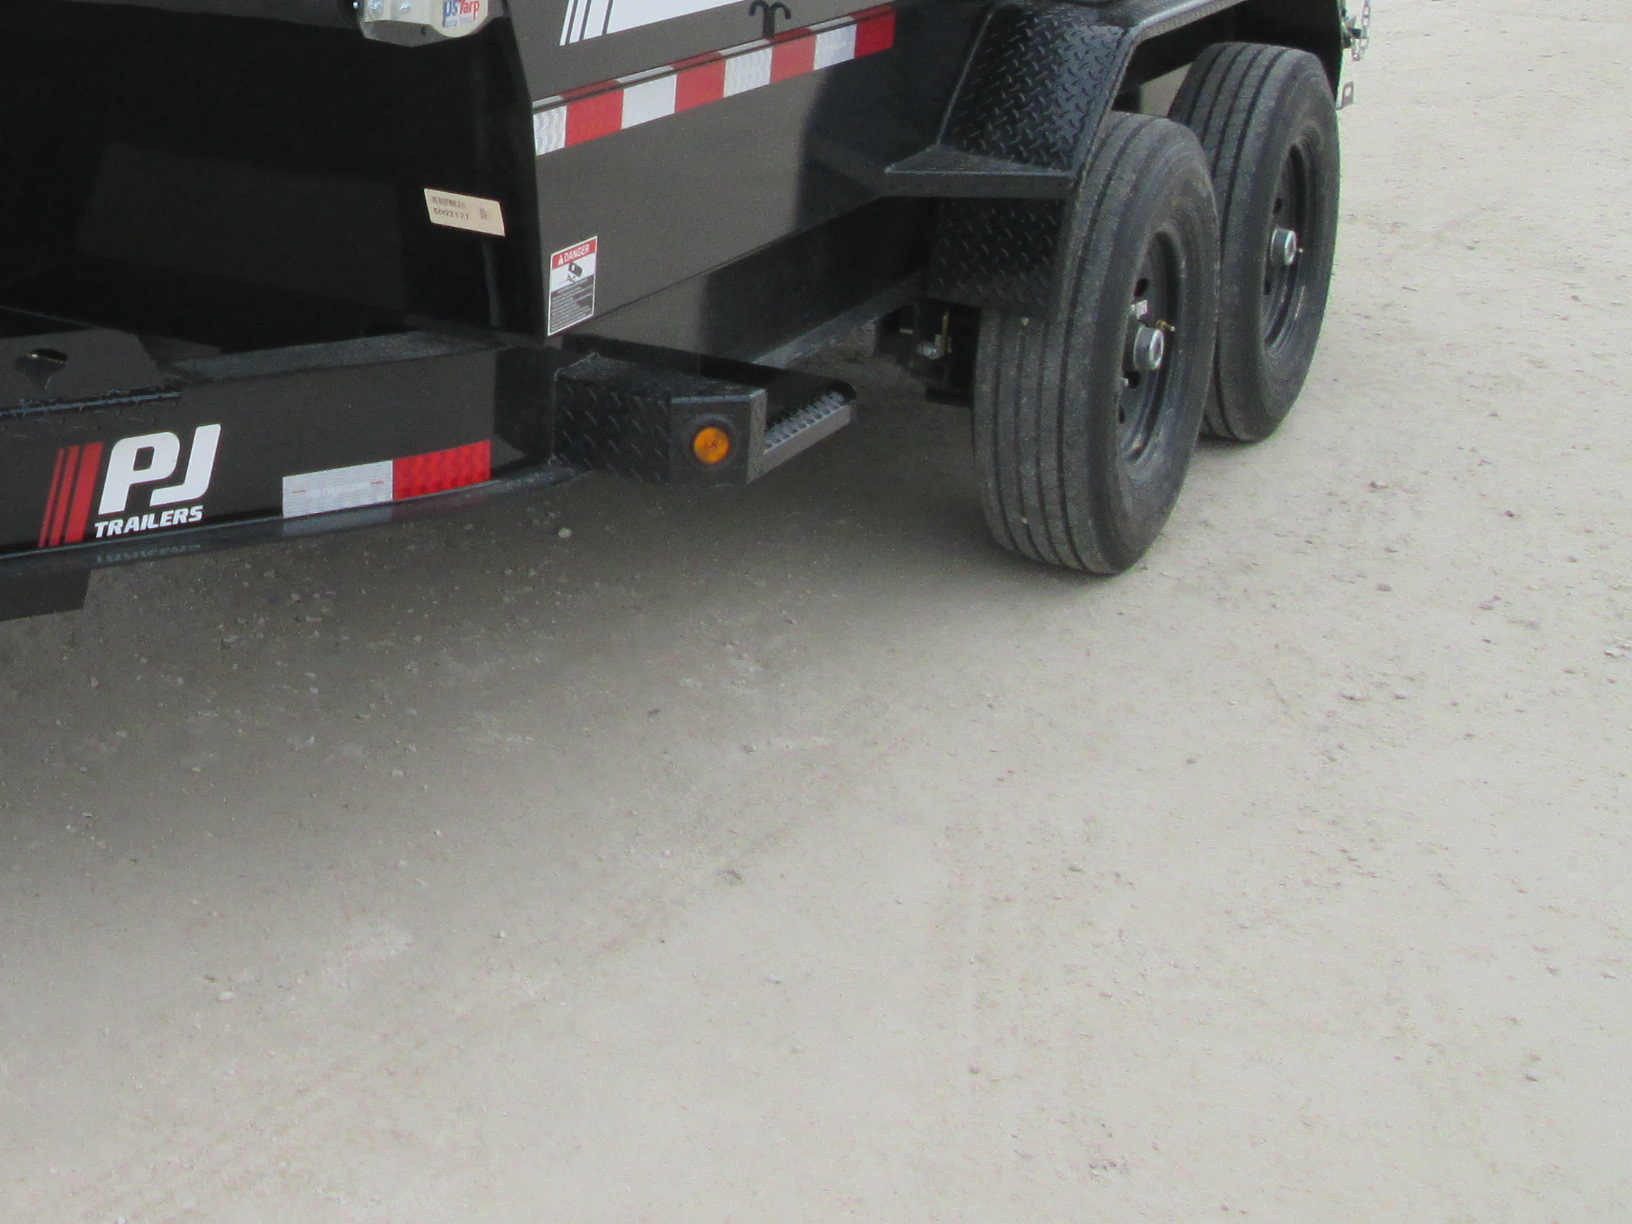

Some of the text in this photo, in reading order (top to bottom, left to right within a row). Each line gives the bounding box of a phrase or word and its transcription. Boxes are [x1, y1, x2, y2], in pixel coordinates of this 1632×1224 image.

[564, 243, 591, 263] DANGER
[98, 423, 221, 515] PJ
[95, 505, 203, 538] TRAILERS
